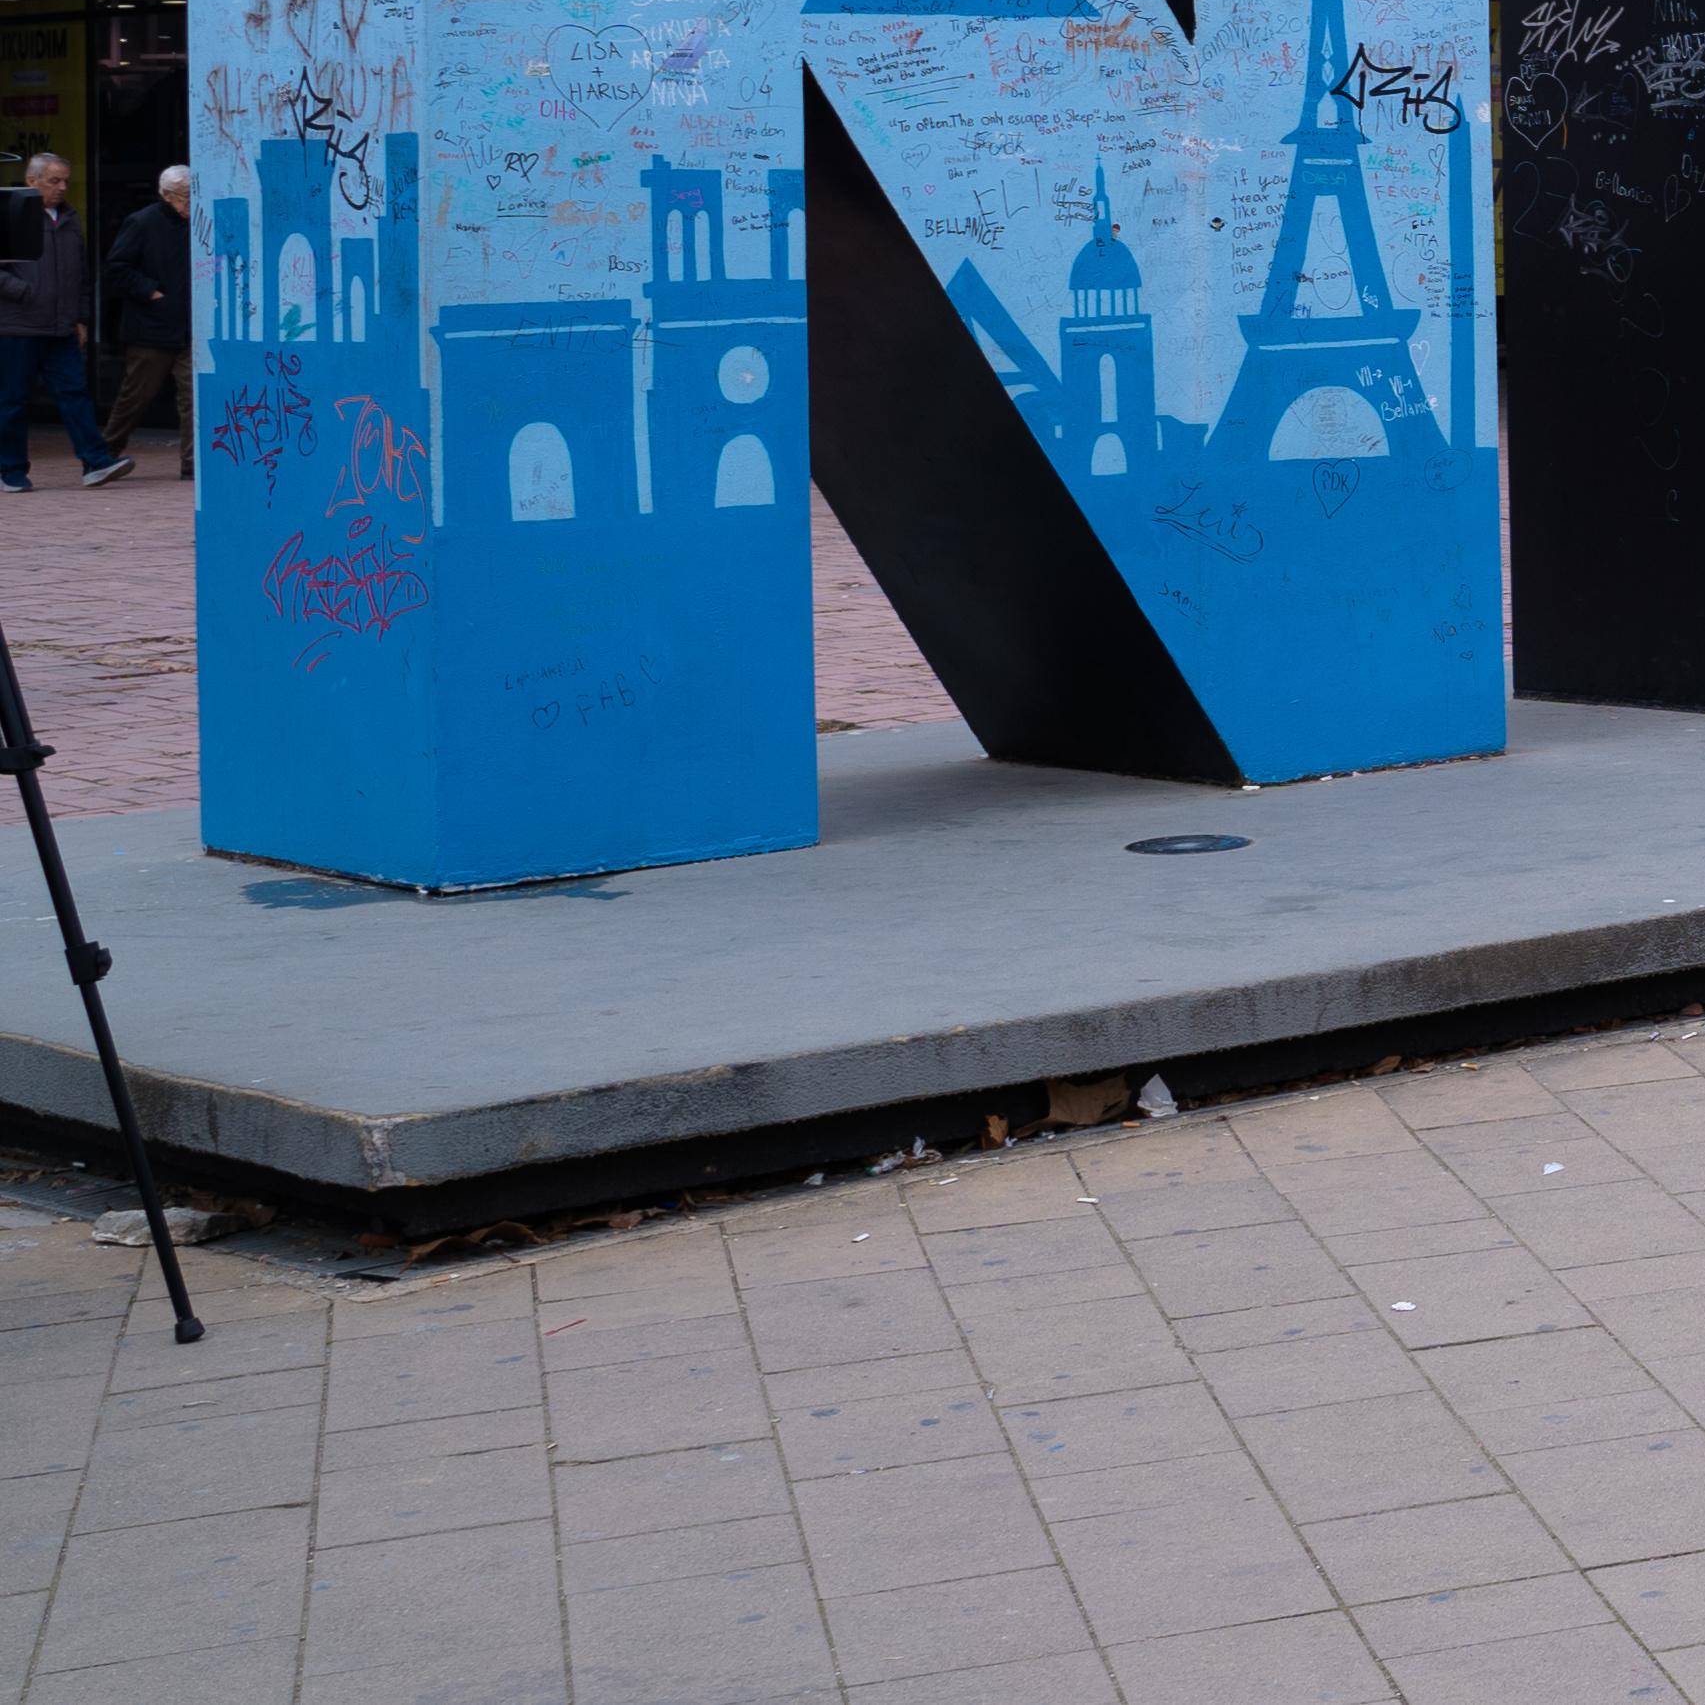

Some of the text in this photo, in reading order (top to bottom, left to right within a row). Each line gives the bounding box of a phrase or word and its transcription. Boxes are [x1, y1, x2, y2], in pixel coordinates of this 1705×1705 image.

[571, 42, 622, 61] LISA
[569, 82, 643, 101] HARISA
[980, 111, 1004, 127] only
[1008, 112, 1050, 130] escape
[1258, 175, 1289, 193] you
